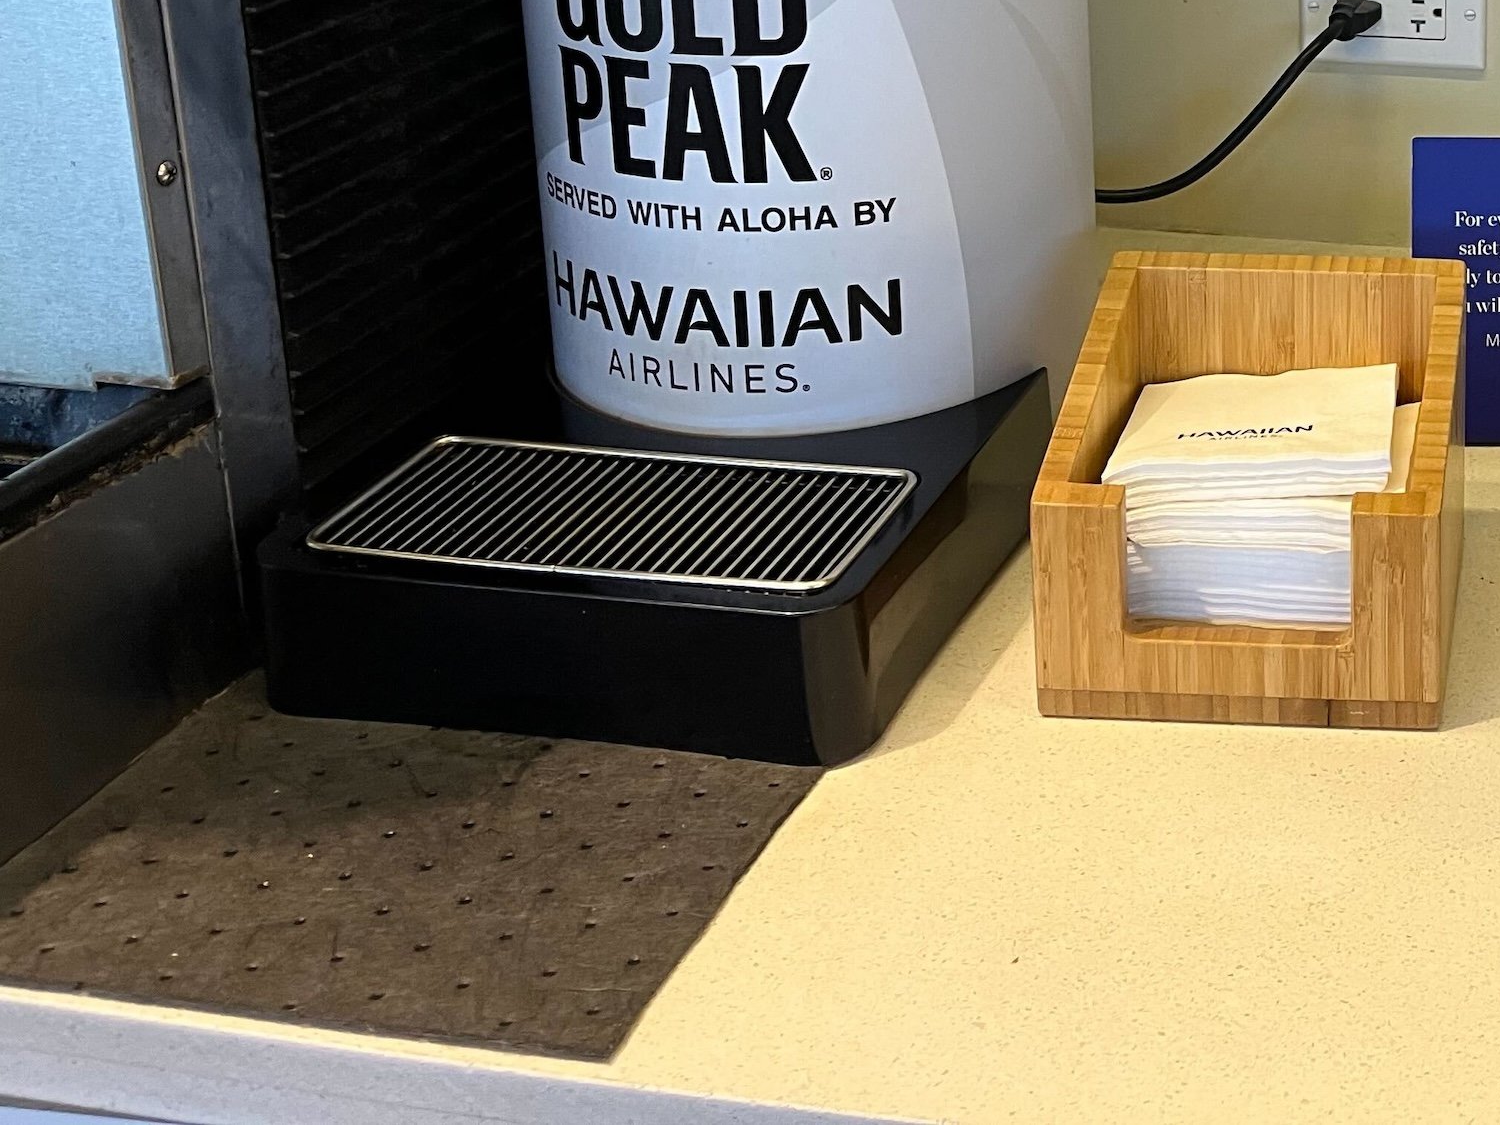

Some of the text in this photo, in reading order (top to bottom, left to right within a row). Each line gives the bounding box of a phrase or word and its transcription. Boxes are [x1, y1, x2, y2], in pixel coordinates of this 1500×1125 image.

[546, 172, 897, 233] SERVED WITH ALOHA BY
[1454, 210, 1484, 228] For
[1466, 267, 1479, 288] ly
[552, 250, 903, 348] HAWAIIAN
[1177, 425, 1313, 440] HAWAIIAN
